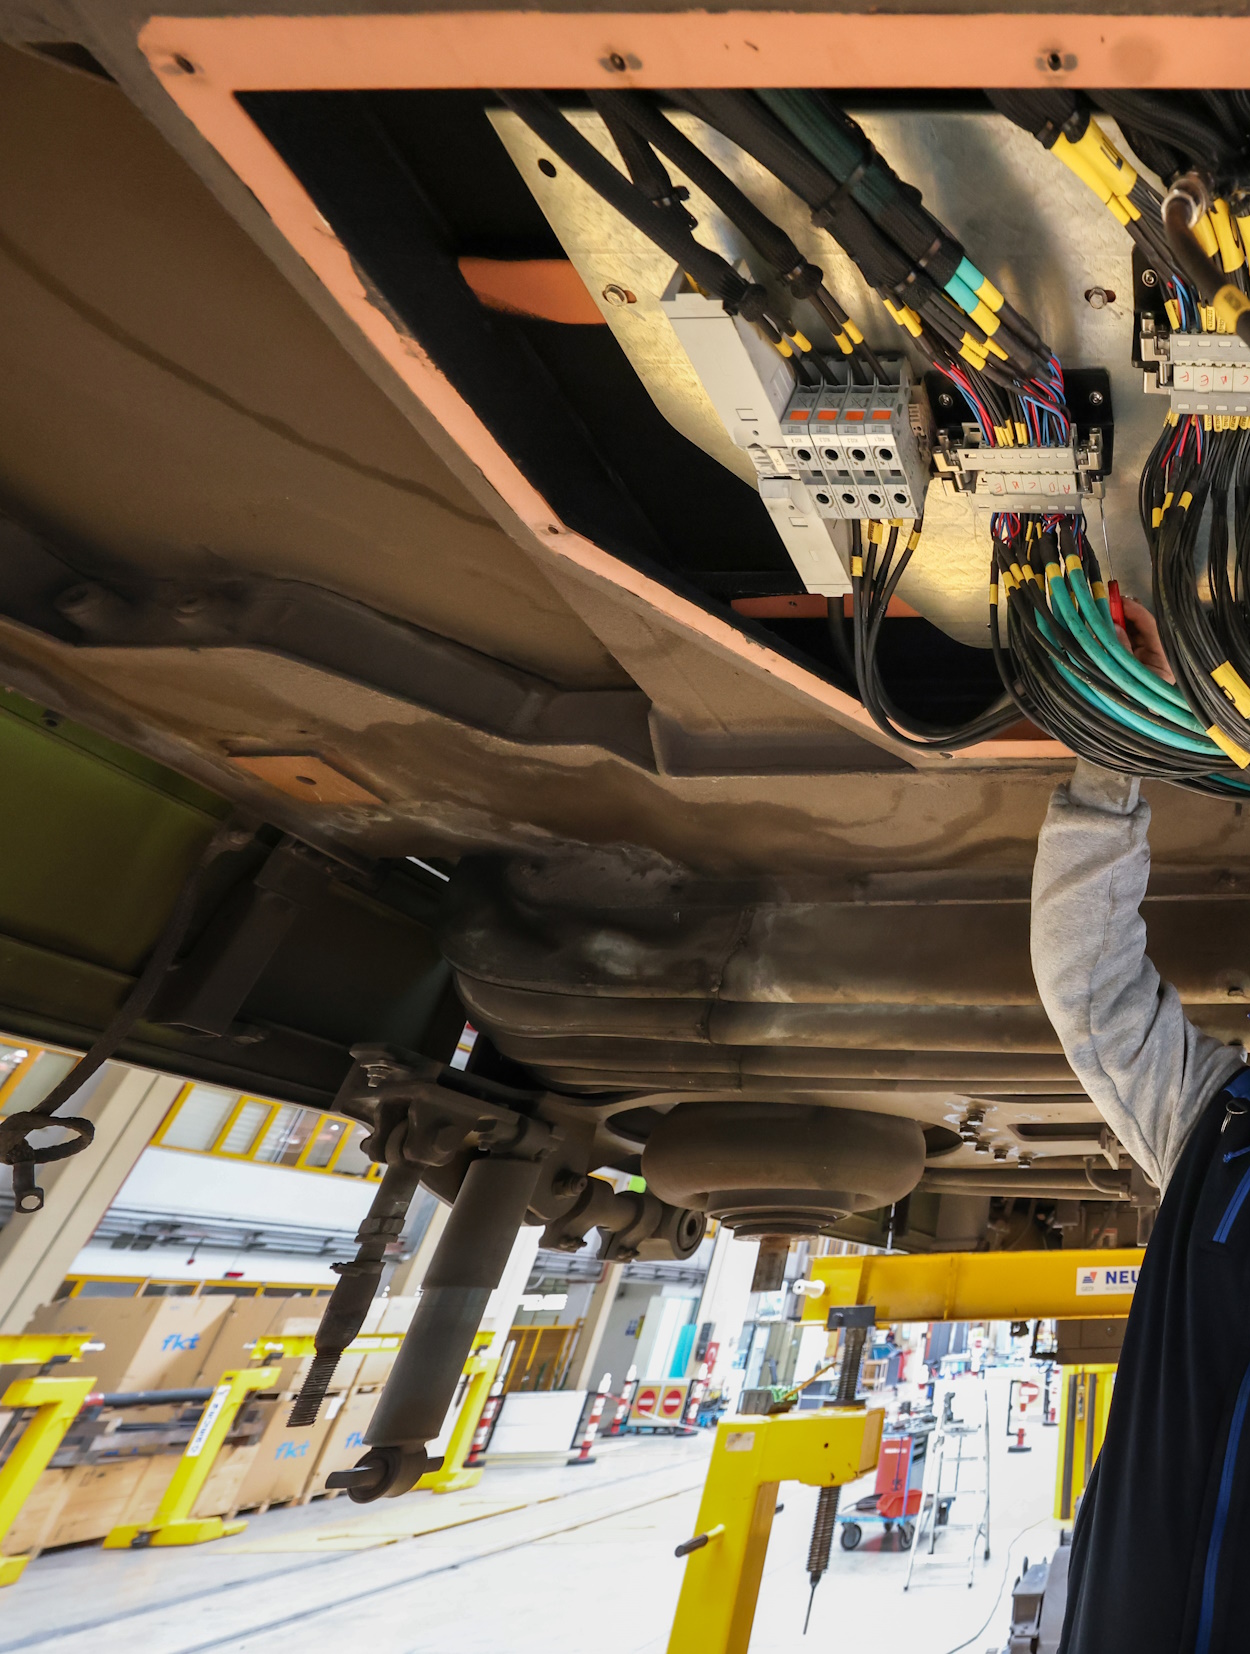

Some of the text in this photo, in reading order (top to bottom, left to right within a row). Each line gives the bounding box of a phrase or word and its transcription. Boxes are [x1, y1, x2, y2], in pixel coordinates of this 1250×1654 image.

[1199, 374, 1209, 387] E
[994, 483, 1002, 494] E
[1062, 484, 1071, 495] A
[161, 1332, 200, 1352] fkt
[345, 1431, 364, 1449] fk
[274, 1439, 311, 1461] fkt
